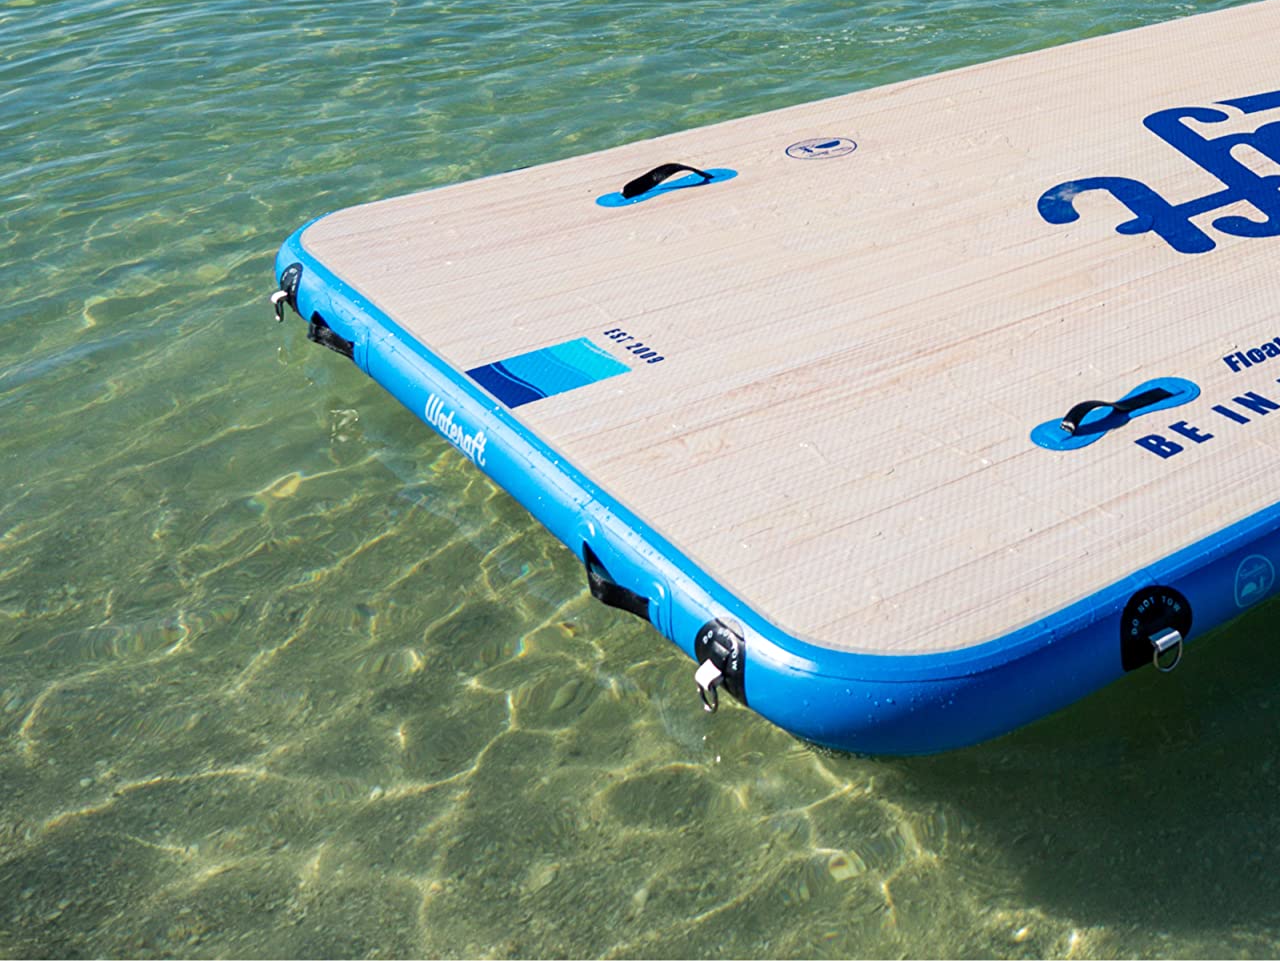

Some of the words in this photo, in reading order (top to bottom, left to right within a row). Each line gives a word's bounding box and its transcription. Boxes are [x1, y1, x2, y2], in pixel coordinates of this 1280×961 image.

[603, 328, 635, 343] EST
[625, 342, 665, 364] 2009
[1134, 420, 1215, 459] BE
[1137, 596, 1155, 614] NOT
[1161, 595, 1181, 612] TOW
